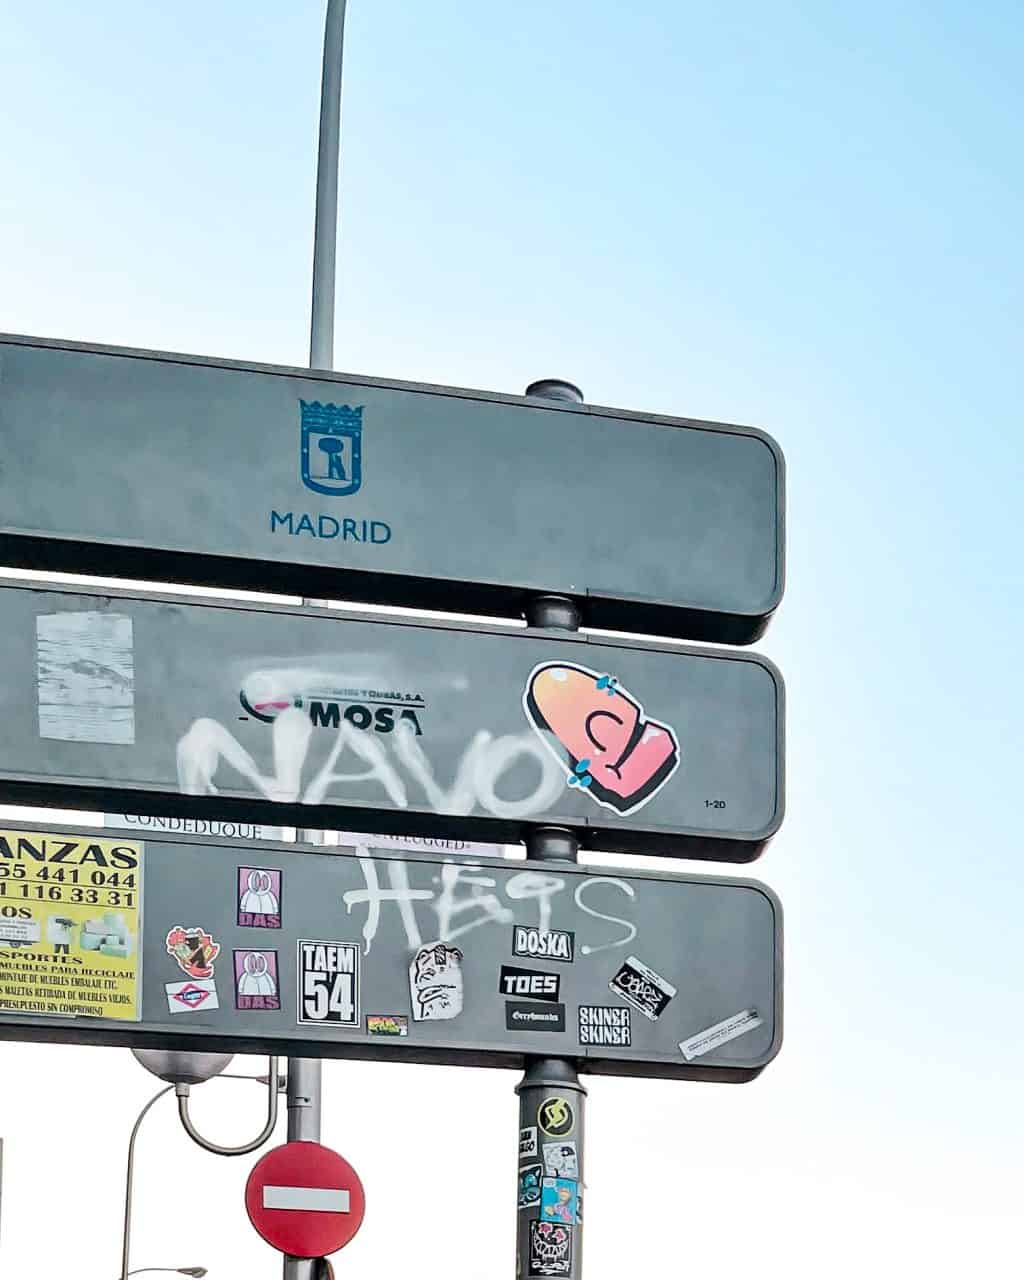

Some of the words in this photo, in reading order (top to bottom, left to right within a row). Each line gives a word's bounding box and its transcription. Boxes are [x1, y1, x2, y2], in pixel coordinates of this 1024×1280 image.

[271, 510, 392, 545] MADRID
[36, 866, 79, 884] 441
[91, 870, 136, 888] 044
[21, 884, 62, 900] 116
[70, 888, 98, 904] 33
[107, 891, 133, 906] 31
[239, 914, 281, 929] DAS
[516, 928, 570, 959] DOSKA
[303, 945, 354, 973] TAEM
[504, 975, 557, 993] TOES
[238, 994, 281, 1010] DAS
[303, 971, 355, 1021] 54
